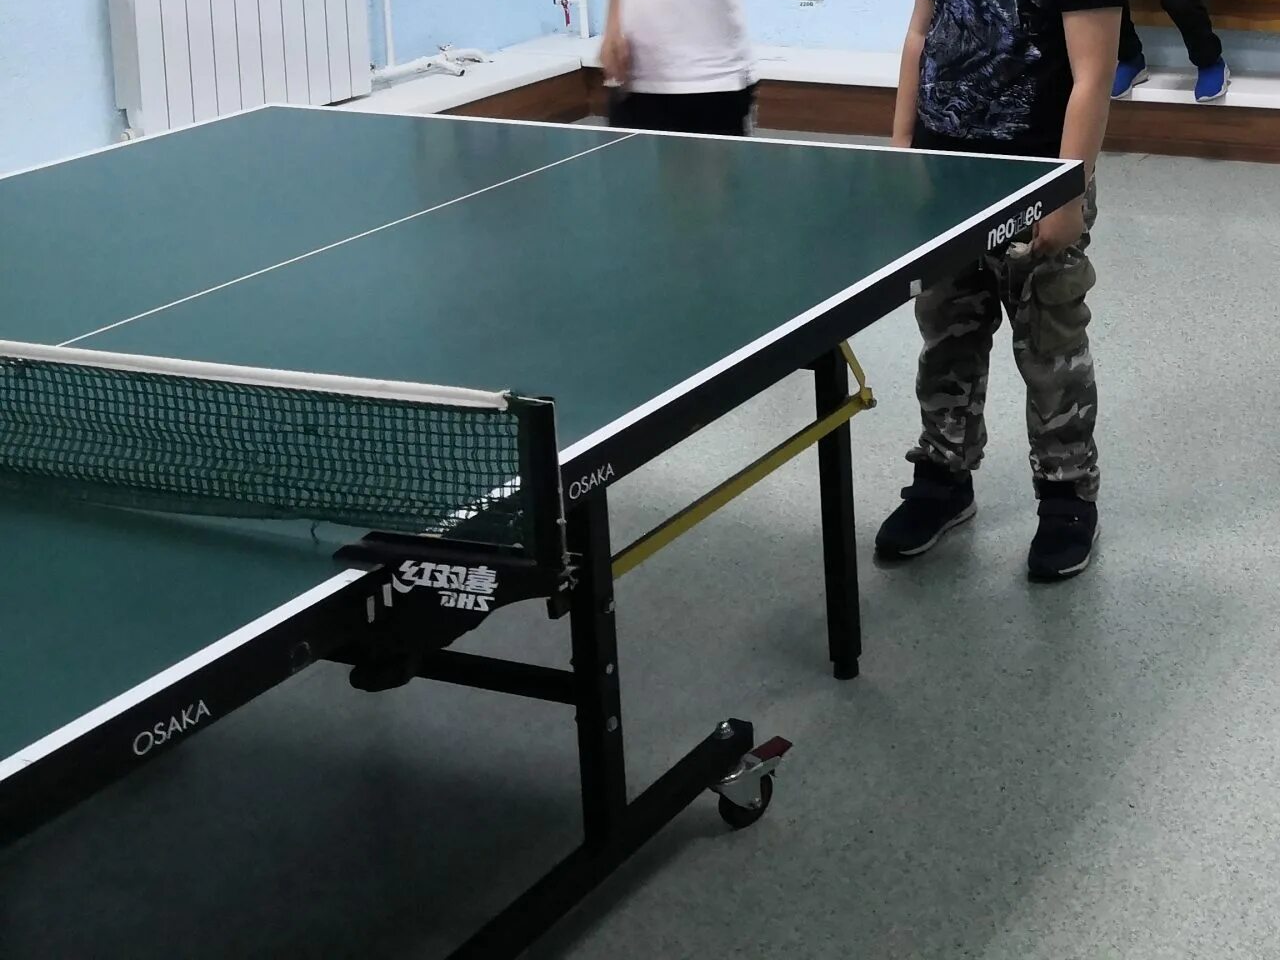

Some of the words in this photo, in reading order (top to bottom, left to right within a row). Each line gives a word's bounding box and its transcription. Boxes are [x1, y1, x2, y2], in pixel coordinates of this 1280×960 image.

[568, 462, 616, 500] OSAKA
[392, 559, 499, 594] 红双喜
[437, 590, 496, 612] DHS
[132, 699, 212, 756] OSAKA
